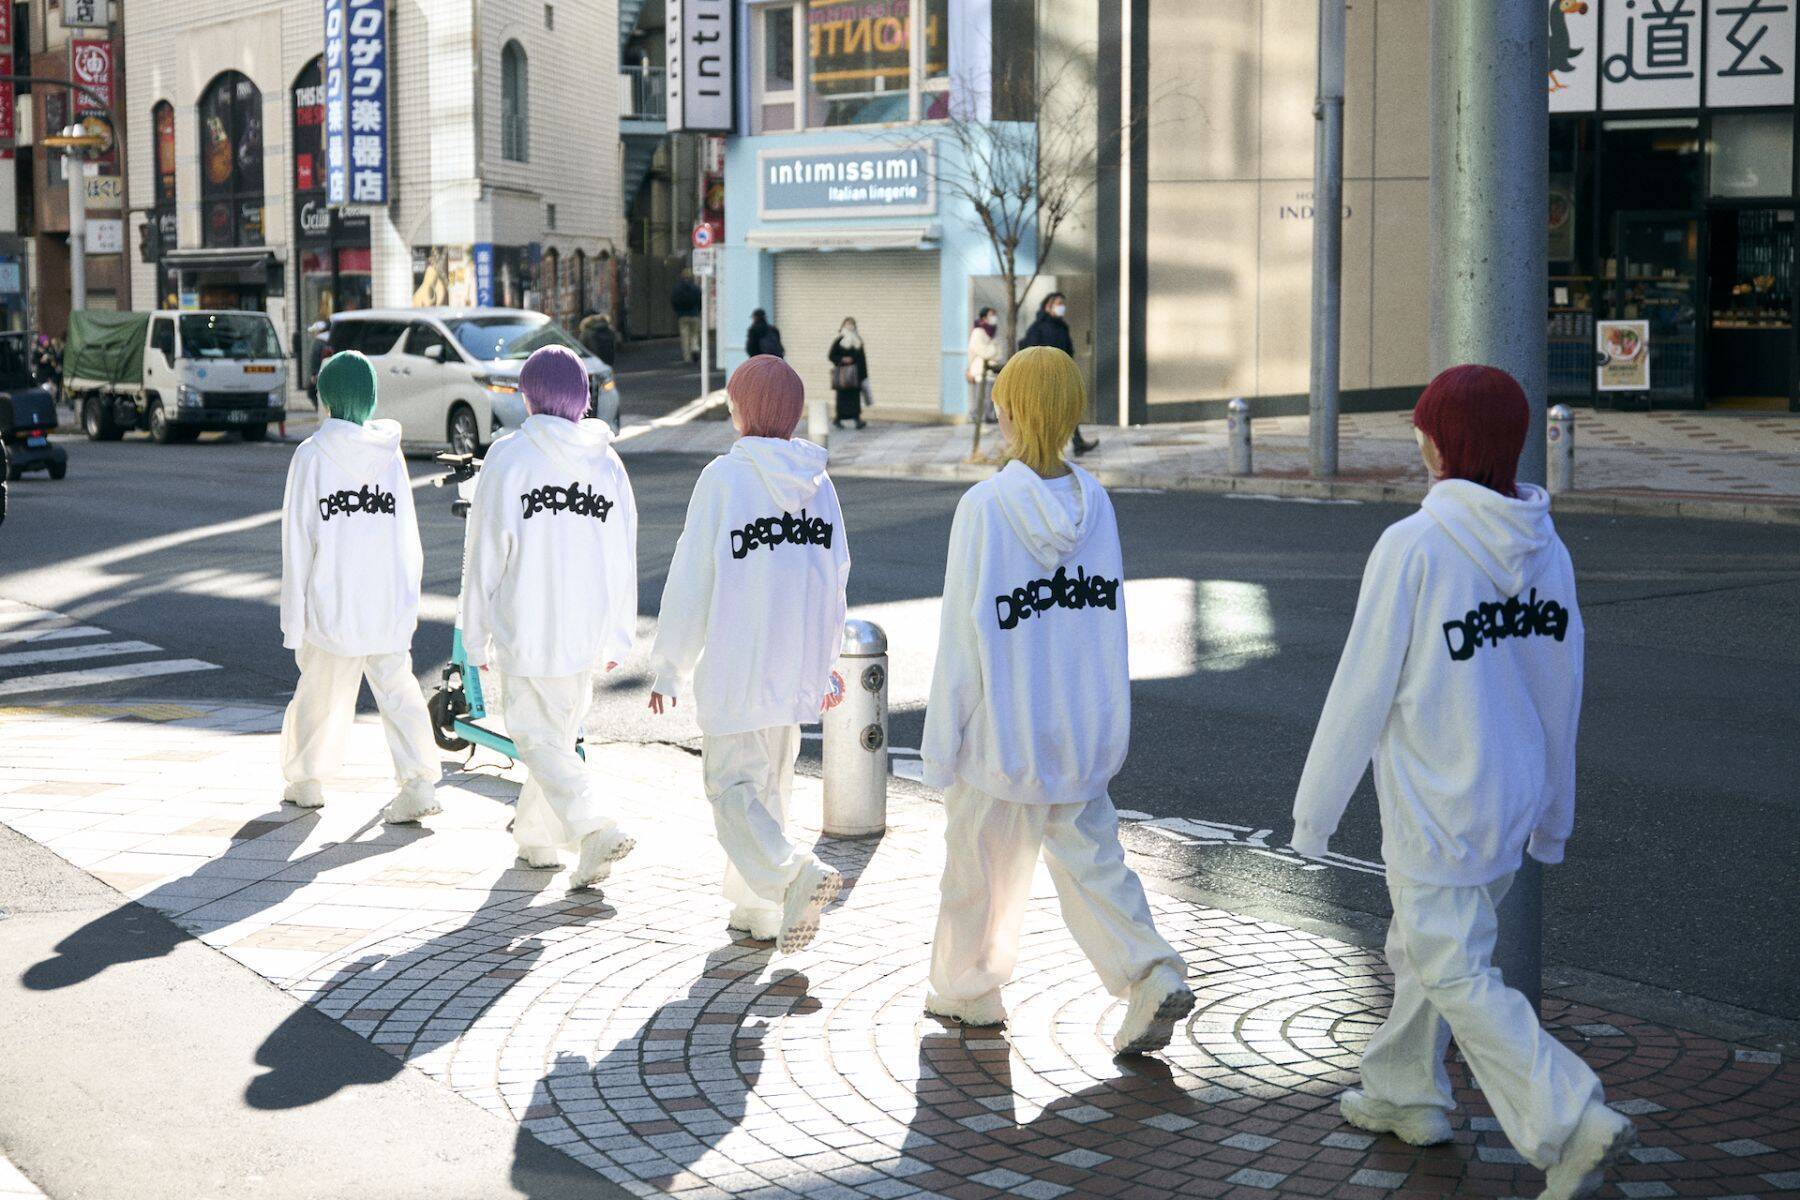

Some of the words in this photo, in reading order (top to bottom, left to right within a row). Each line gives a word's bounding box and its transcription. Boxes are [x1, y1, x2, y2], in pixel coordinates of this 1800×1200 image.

[692, 0, 721, 97] inti
[326, 0, 343, 201] ロサワ楽器店
[349, 0, 383, 201] ロサワ楽器店
[770, 158, 918, 185] intimissimi
[829, 185, 868, 202] Italian
[869, 183, 918, 203] lingerie
[1280, 205, 1353, 219] IND
